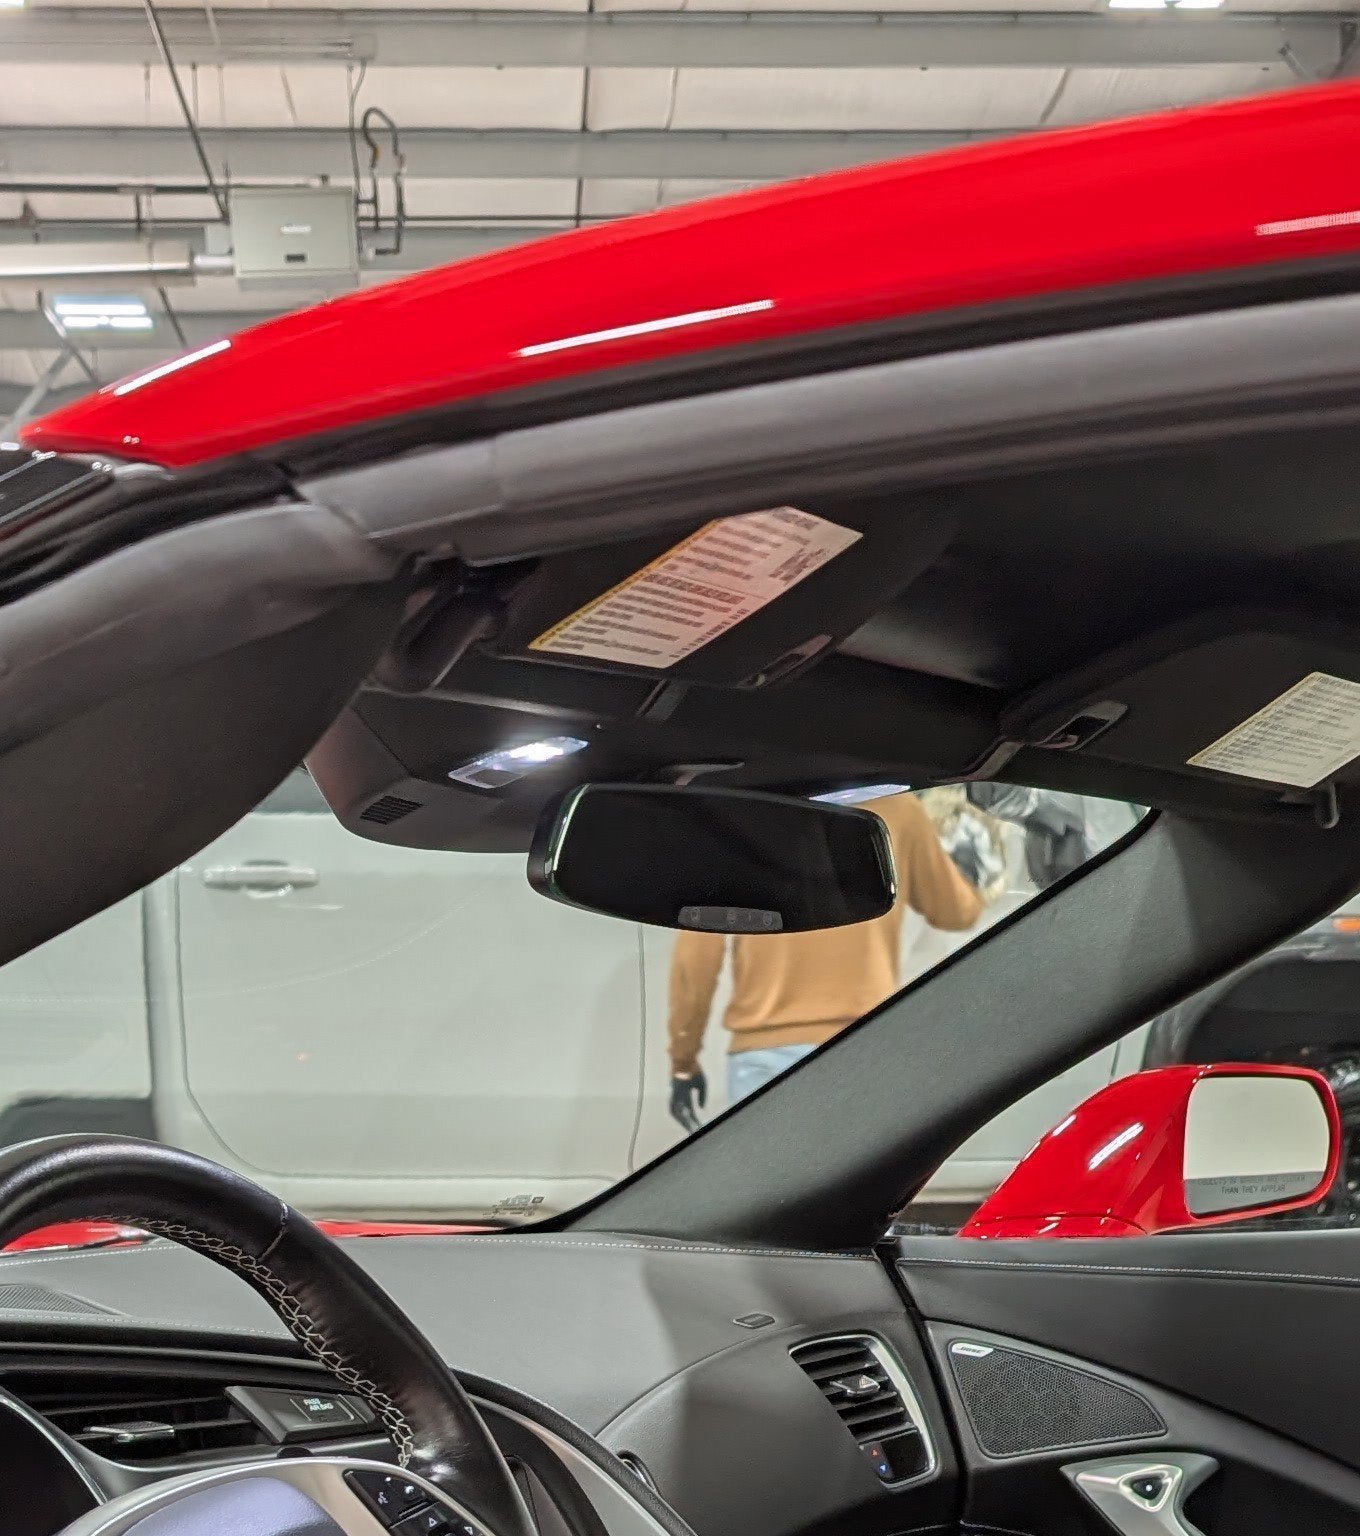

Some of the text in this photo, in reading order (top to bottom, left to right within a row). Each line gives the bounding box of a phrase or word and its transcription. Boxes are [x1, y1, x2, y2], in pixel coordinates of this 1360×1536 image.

[1221, 1183, 1287, 1194] THAN THEY APPEAR
